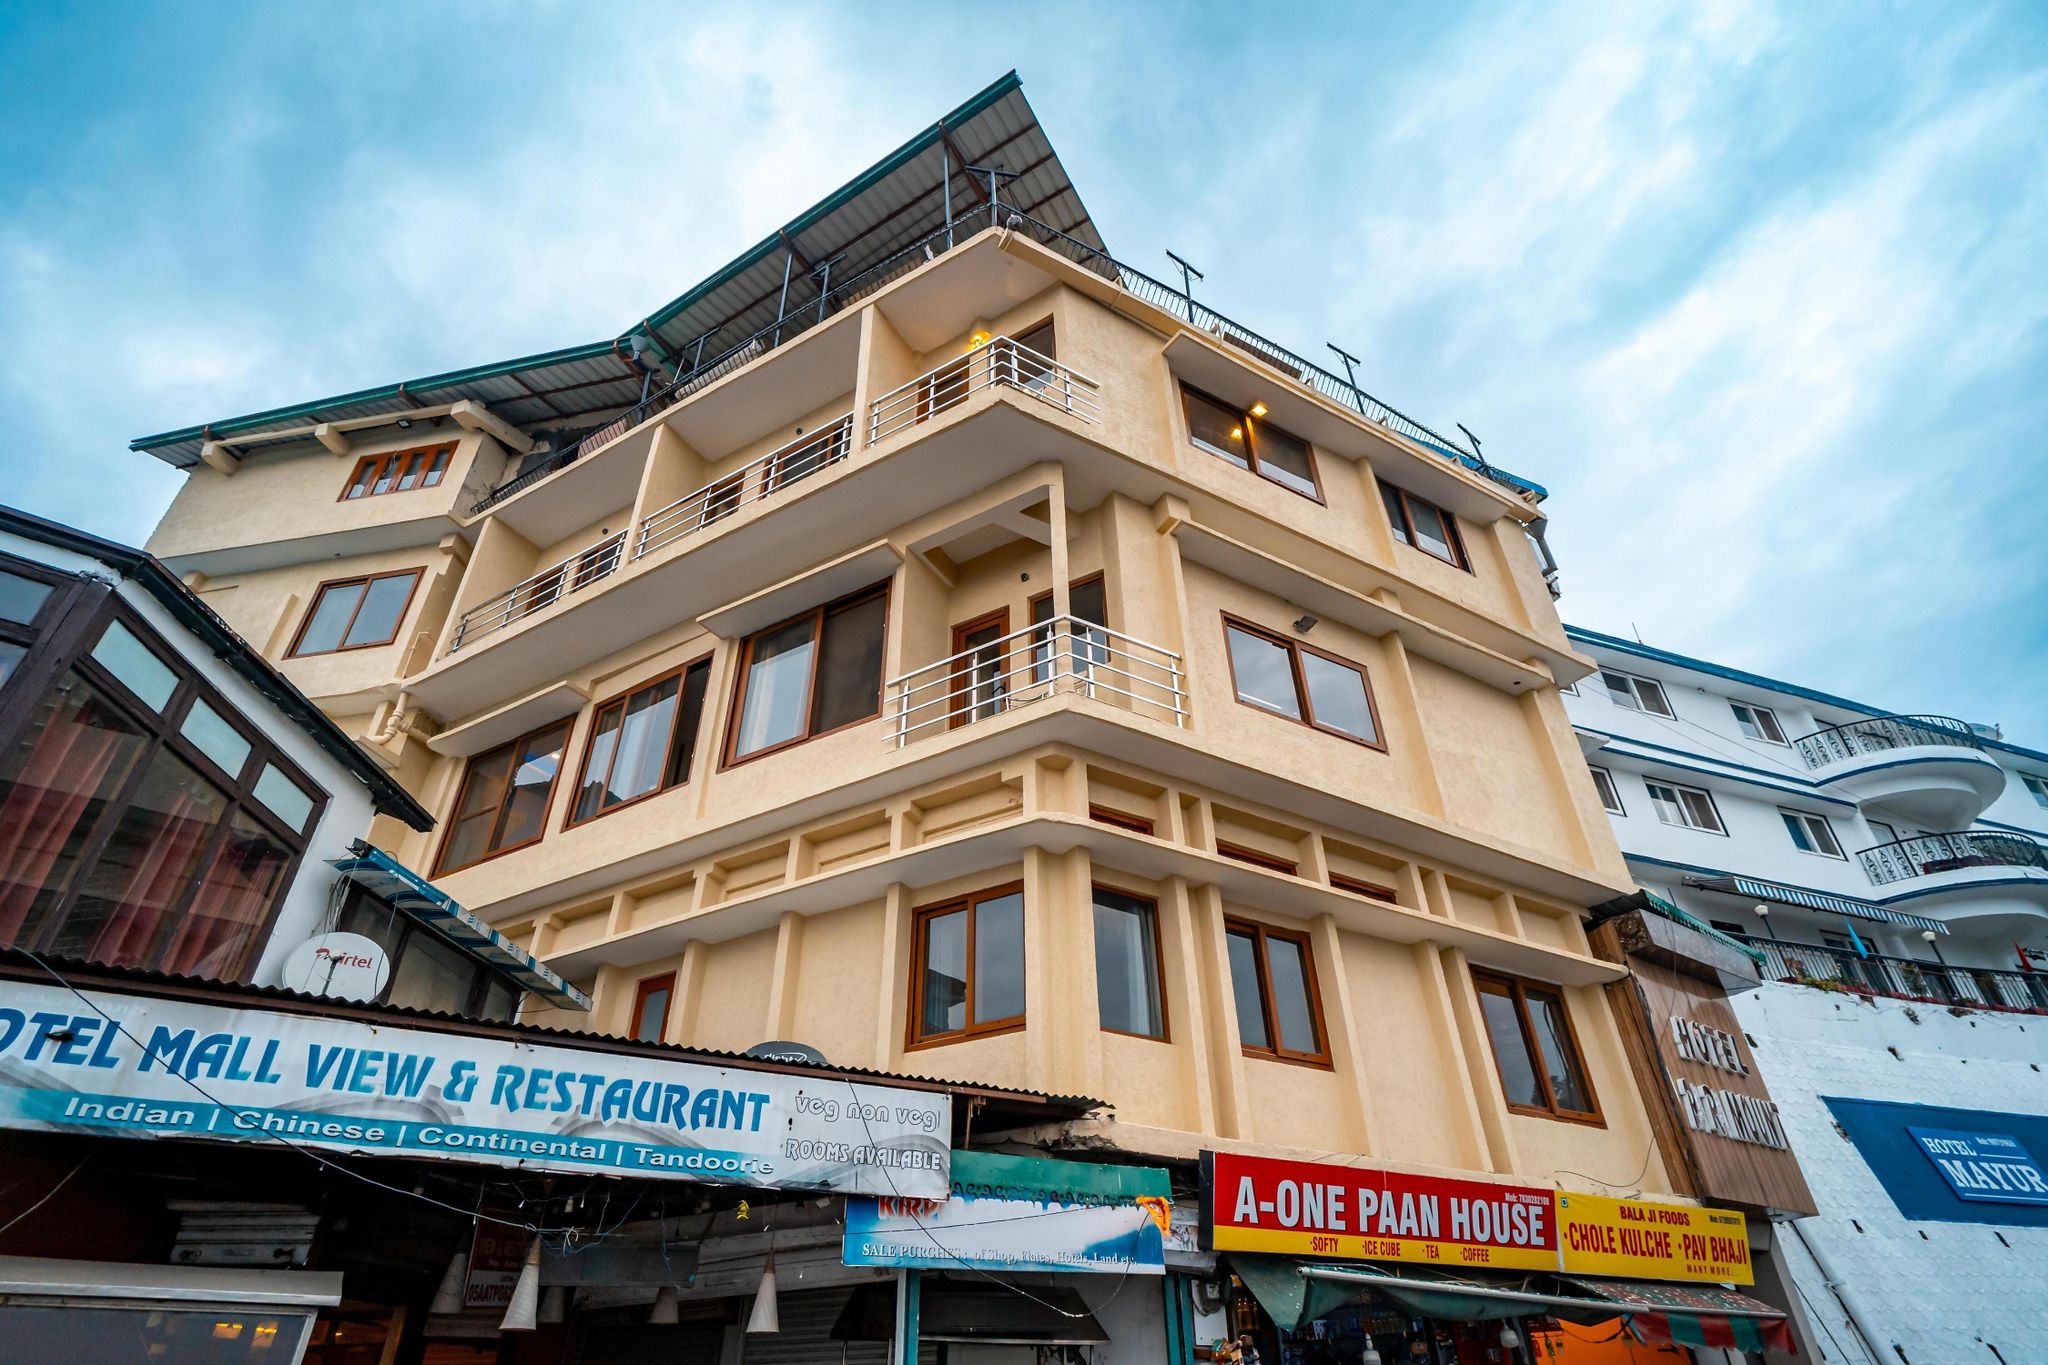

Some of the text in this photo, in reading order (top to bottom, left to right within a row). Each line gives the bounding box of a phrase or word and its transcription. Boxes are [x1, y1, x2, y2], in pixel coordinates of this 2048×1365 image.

[1670, 1016, 1750, 1077] HOTEL
[137, 1026, 281, 1085] MALL
[306, 1044, 435, 1098] VIEW
[443, 1060, 479, 1102] &
[490, 1064, 770, 1132] RESTAURANT
[795, 1095, 938, 1132] veg non veg
[64, 1097, 774, 1174] Indian Chinese Continental Tandoorie
[1921, 1137, 1977, 1156] HOTEL
[785, 1138, 941, 1171] ROOMS AVAILABLE
[1937, 1158, 2048, 1193] MAYUR
[1234, 1175, 1546, 1246] A-ONE PAAN HOUSE
[1619, 1205, 1690, 1226] BALA JI FOODS
[862, 1243, 897, 1258] SALE
[1094, 1252, 1118, 1265] Land
[1312, 1236, 1490, 1262] SOFTY ICE CUBE TEA COFFEE
[1568, 1222, 1748, 1265] CHOLE KULCHE PAV BHAJI
[1686, 1264, 1708, 1275] MANY
